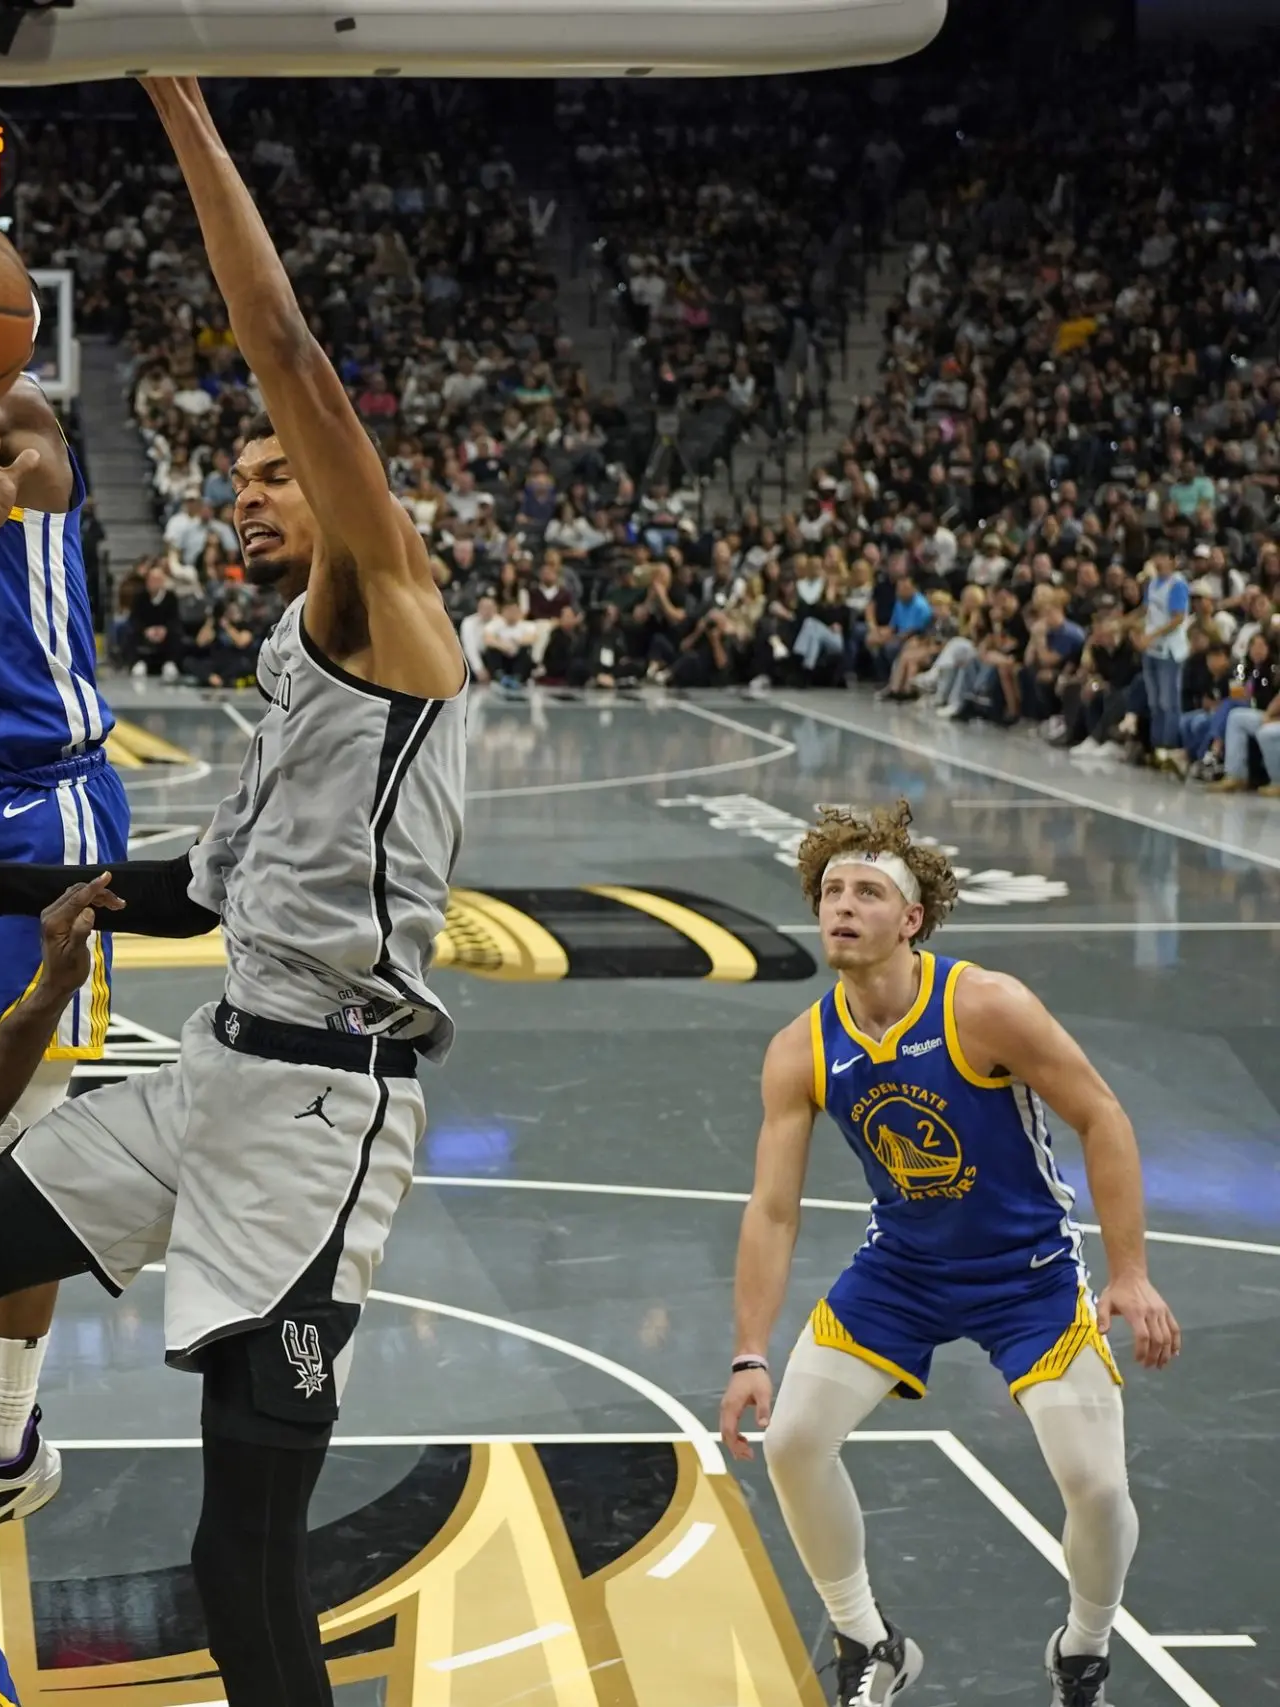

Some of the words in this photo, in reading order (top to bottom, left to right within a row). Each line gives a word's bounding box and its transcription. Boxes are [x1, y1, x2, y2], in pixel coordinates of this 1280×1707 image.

[901, 1037, 943, 1057] Rakuten
[851, 1082, 899, 1122] GOLDEN
[901, 1083, 948, 1111] STATE
[917, 1119, 941, 1148] 2
